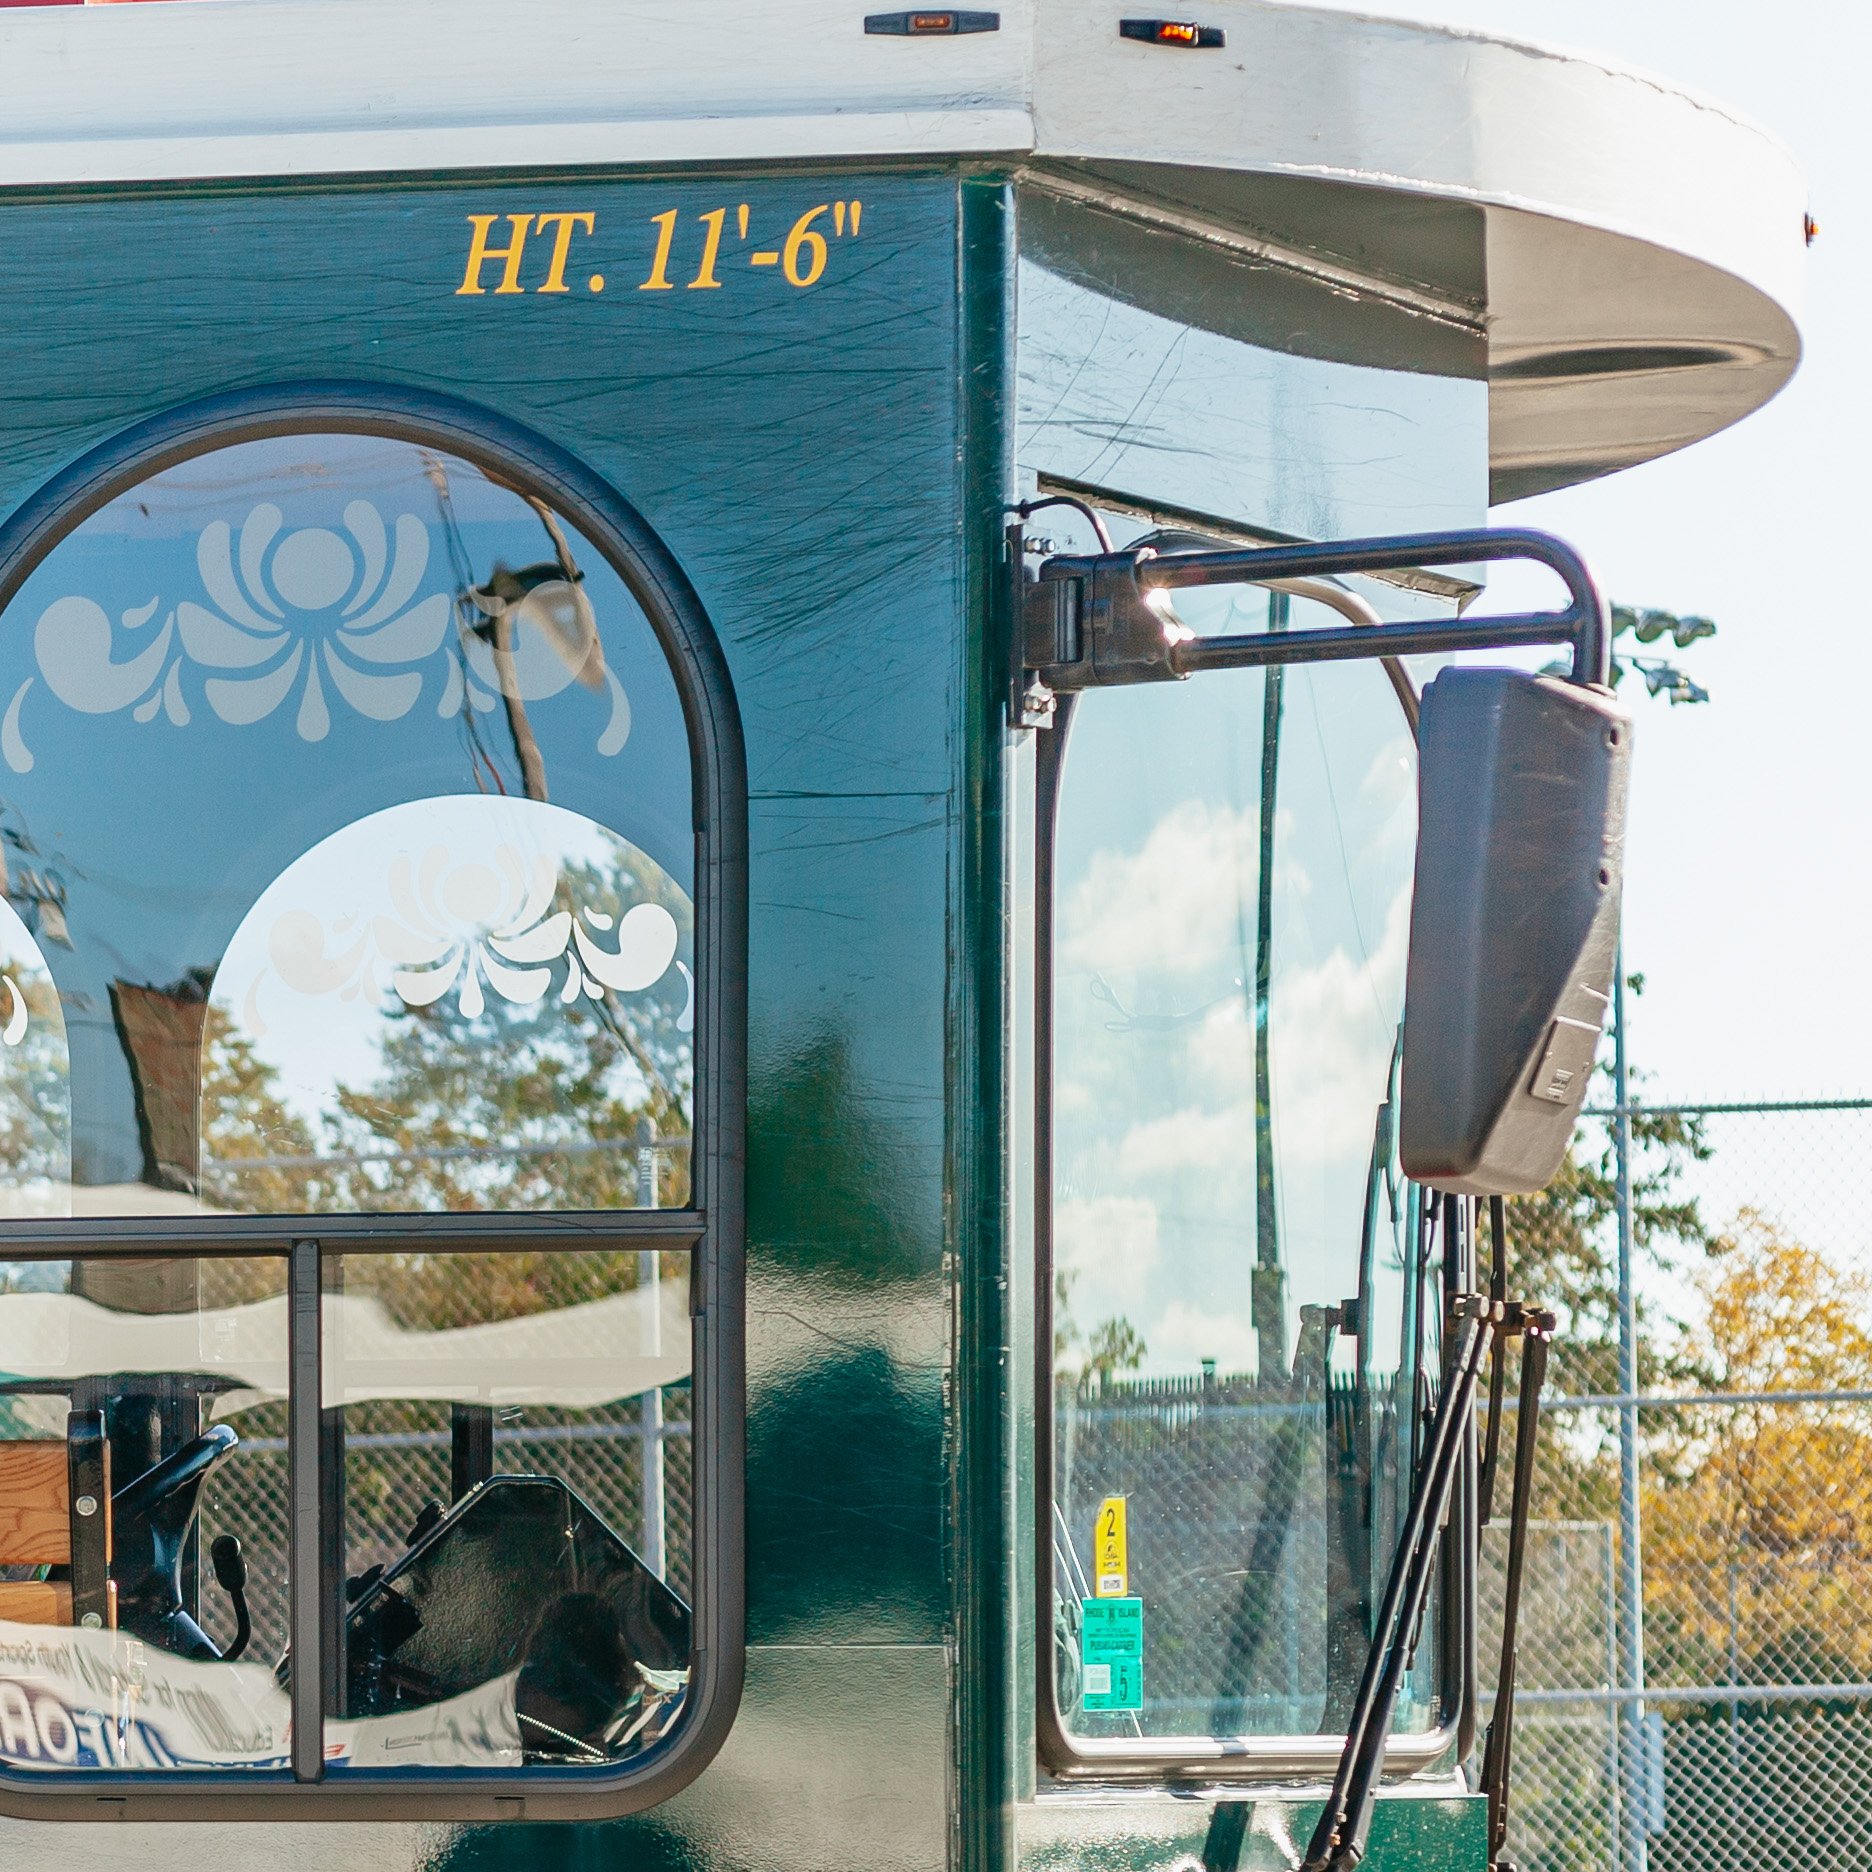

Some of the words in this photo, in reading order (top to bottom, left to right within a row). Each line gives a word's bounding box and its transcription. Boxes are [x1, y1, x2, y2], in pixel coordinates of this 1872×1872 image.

[456, 211, 606, 294] HT.
[639, 201, 863, 290] 11'-6"
[1106, 1507, 1116, 1537] 2
